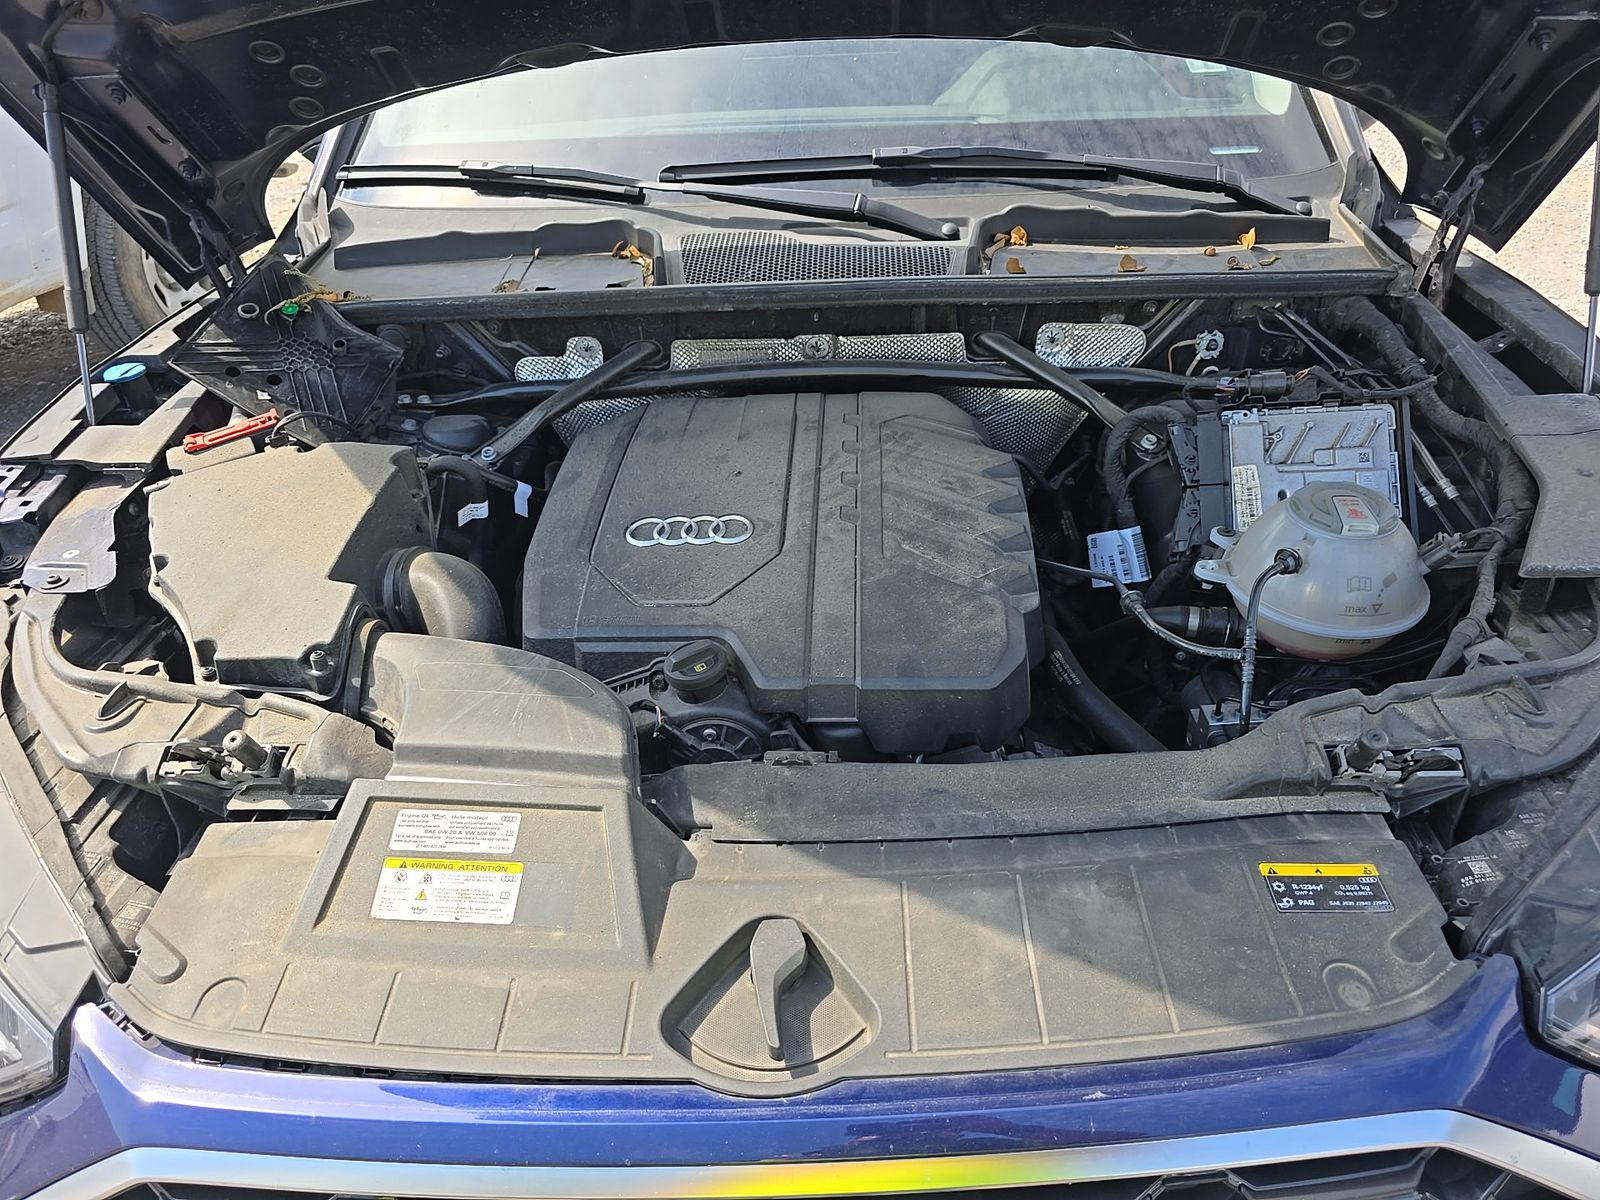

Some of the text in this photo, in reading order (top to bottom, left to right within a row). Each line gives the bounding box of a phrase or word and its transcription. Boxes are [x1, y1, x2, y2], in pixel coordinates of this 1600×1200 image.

[1344, 606, 1368, 614] max
[411, 862, 508, 873] WARNING ATTENTION
[1291, 883, 1324, 891] R-1234yf
